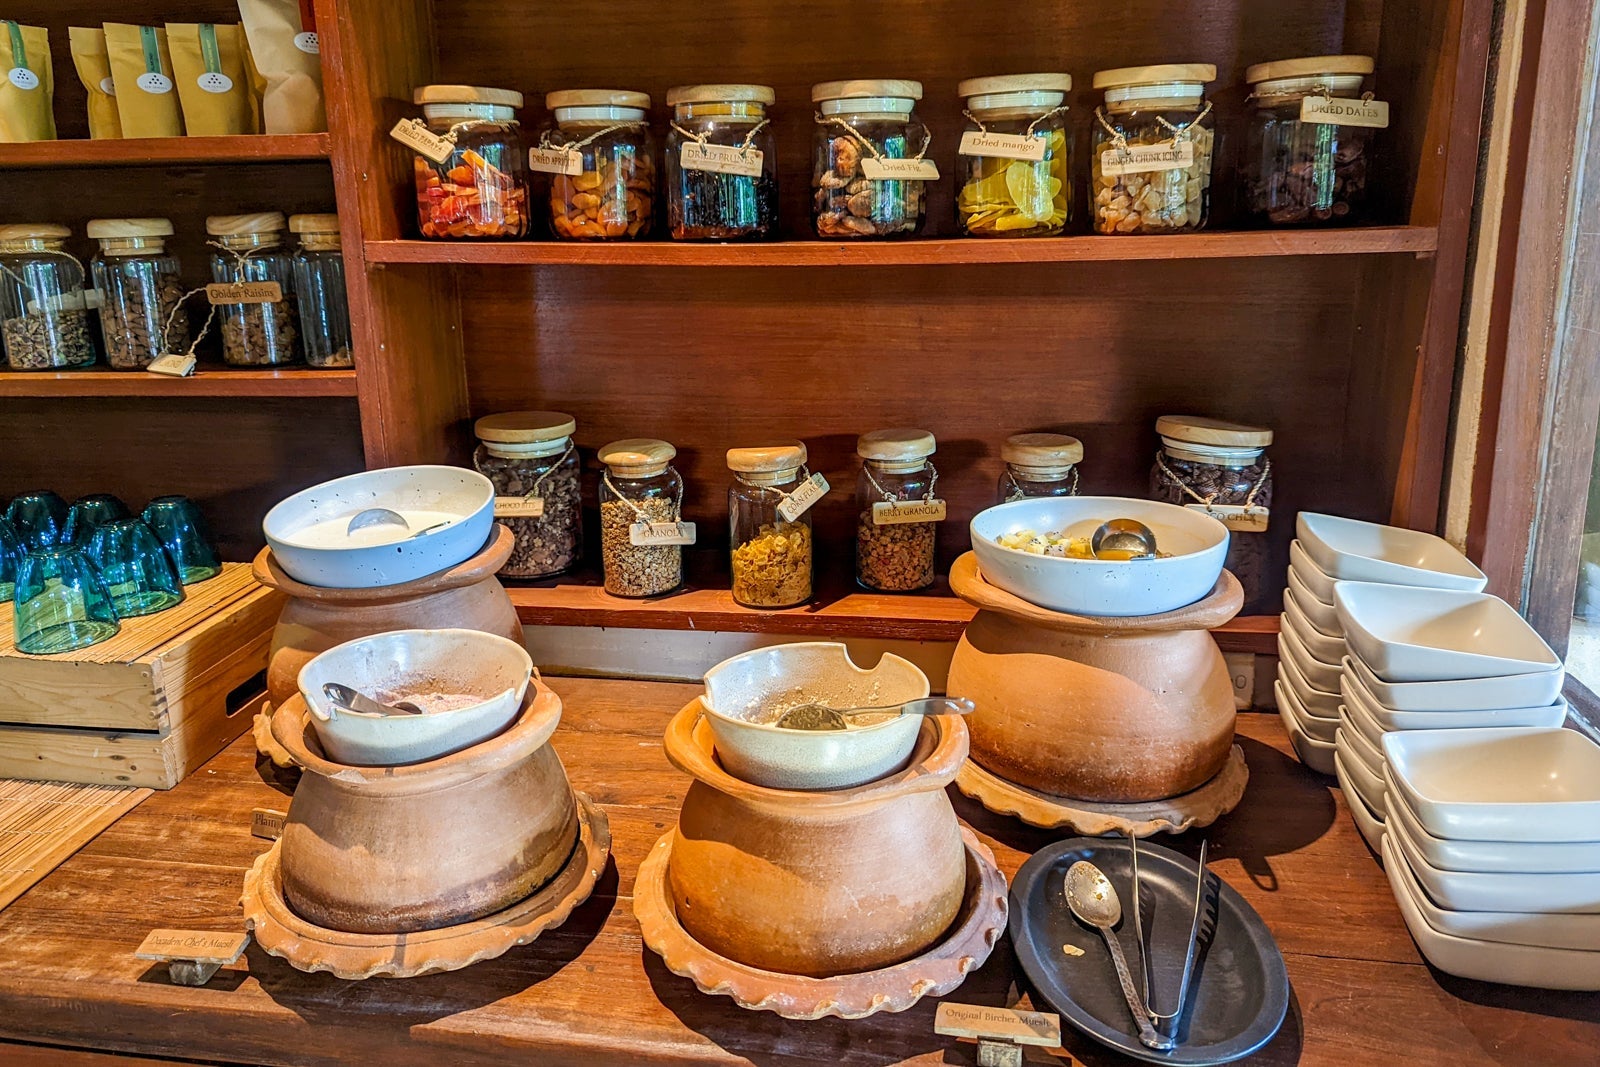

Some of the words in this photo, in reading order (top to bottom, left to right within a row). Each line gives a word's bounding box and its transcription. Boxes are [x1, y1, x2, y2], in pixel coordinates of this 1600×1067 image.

[1311, 103, 1344, 115] DRIED
[1346, 106, 1379, 118] DATES
[398, 125, 420, 139] DRIED
[420, 135, 444, 153] PAPAYA
[972, 137, 999, 148] Dried
[1002, 140, 1035, 152] mango
[532, 154, 550, 165] DRIED
[1135, 151, 1162, 164] CHUNK
[1162, 150, 1183, 162] ICING
[210, 289, 242, 299] Golden
[244, 288, 274, 298] Raisins
[495, 502, 521, 510] CHOCO
[786, 495, 804, 514] CORN
[879, 507, 901, 517] BERRY
[903, 506, 940, 516] GRANOLA
[255, 813, 277, 828] Plain
[184, 936, 207, 947] Chef's
[945, 1008, 982, 1021] Original
[984, 1012, 1016, 1023] Bircher
[1018, 1016, 1050, 1027] Muesli
